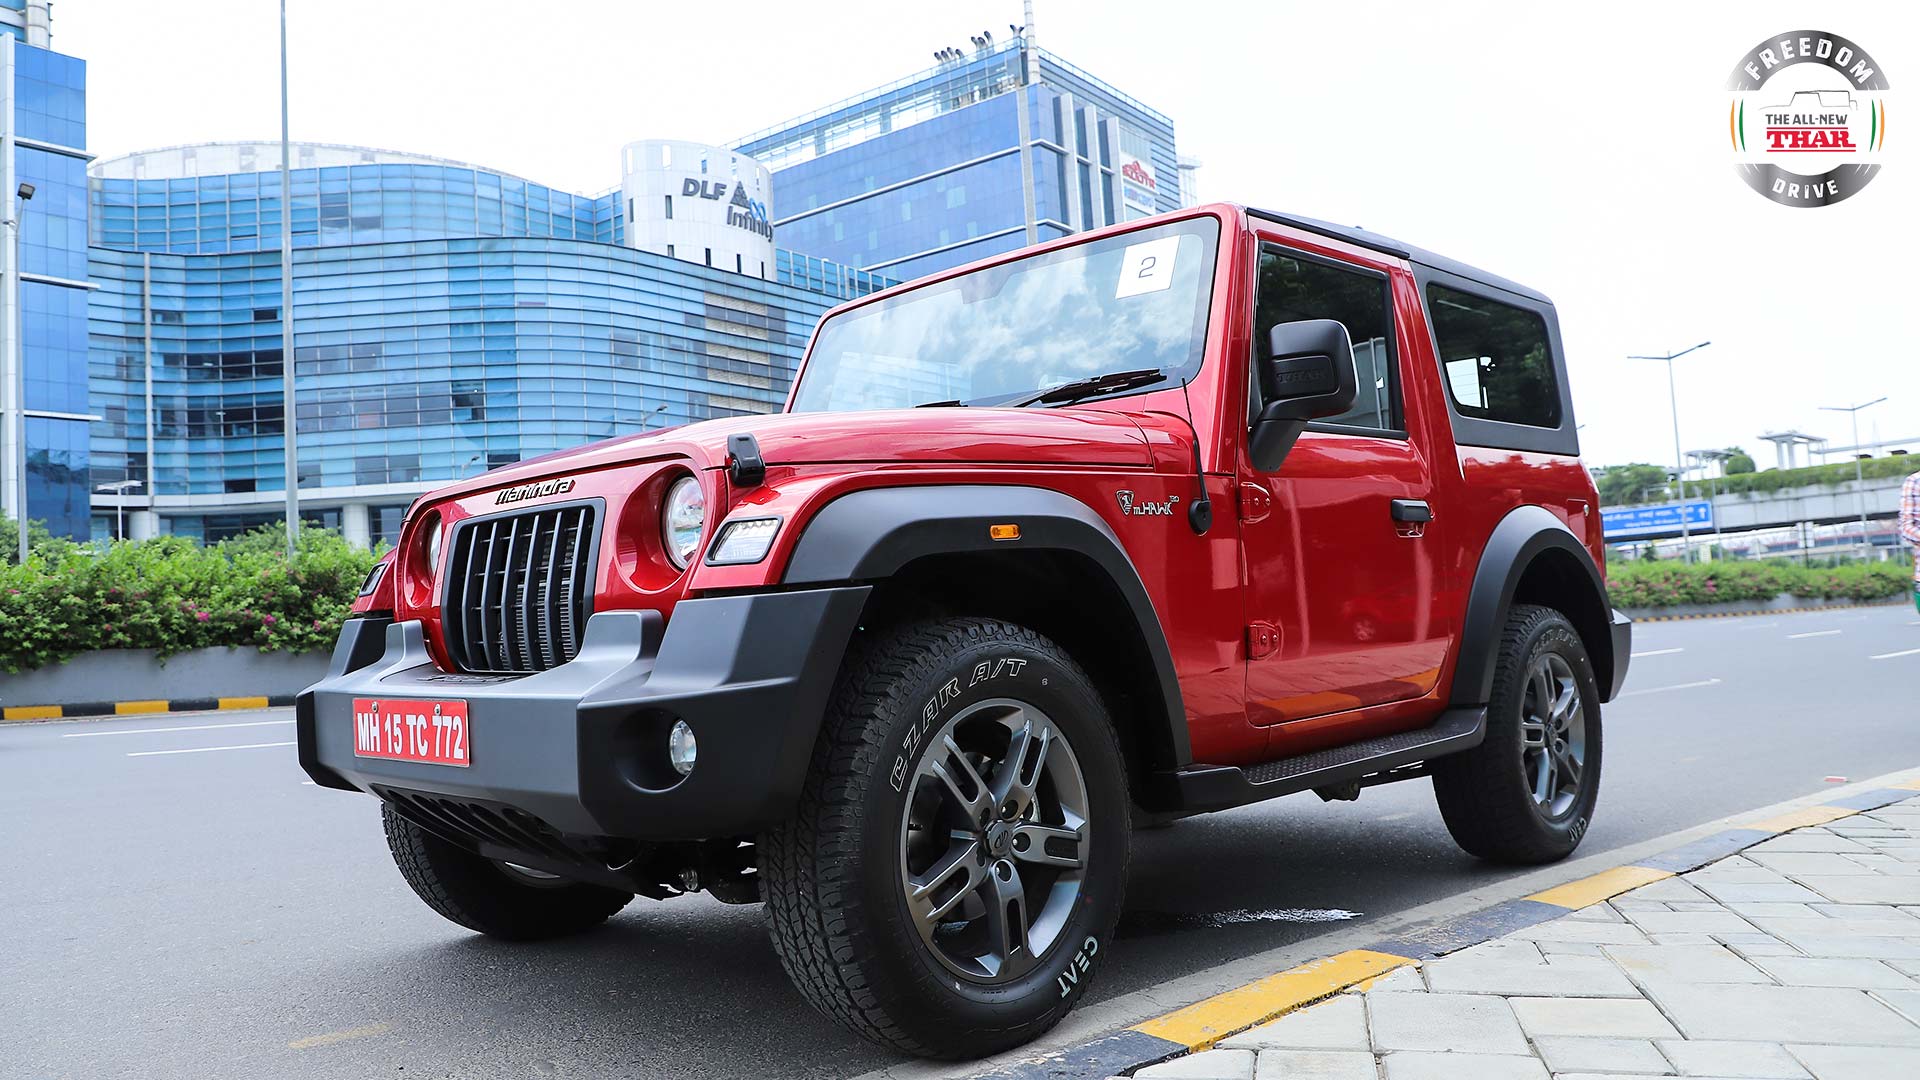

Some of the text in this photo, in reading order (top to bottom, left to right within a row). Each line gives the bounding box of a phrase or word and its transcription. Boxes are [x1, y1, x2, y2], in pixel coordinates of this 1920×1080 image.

[682, 177, 727, 201] DLF
[1138, 256, 1157, 279] 2
[357, 712, 464, 760] MH 15 TC 772
[890, 658, 1027, 792] CZAR A/T
[1057, 936, 1099, 998] CEAT
